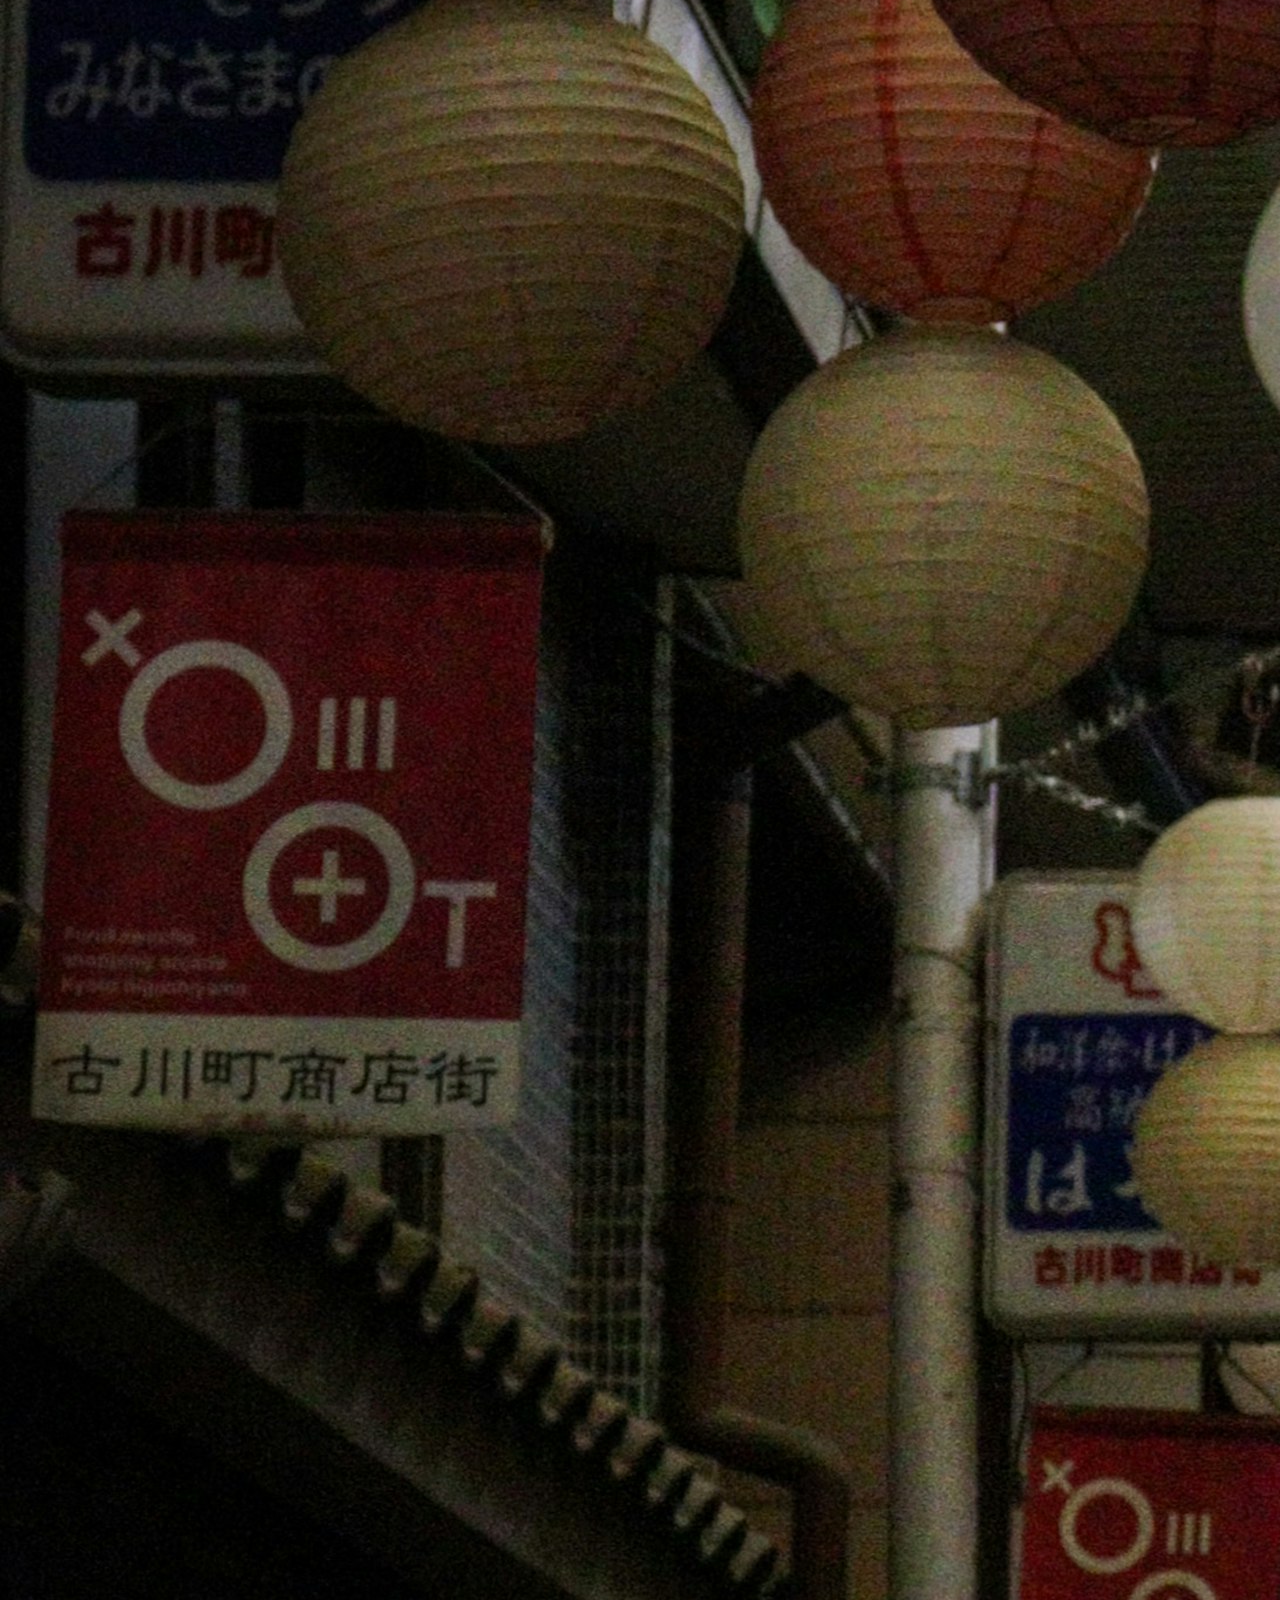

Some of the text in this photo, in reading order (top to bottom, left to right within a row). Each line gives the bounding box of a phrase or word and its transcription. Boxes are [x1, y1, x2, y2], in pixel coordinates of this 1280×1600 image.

[73, 203, 277, 279] 古川町
[51, 1045, 500, 1107] 古川町商店街
